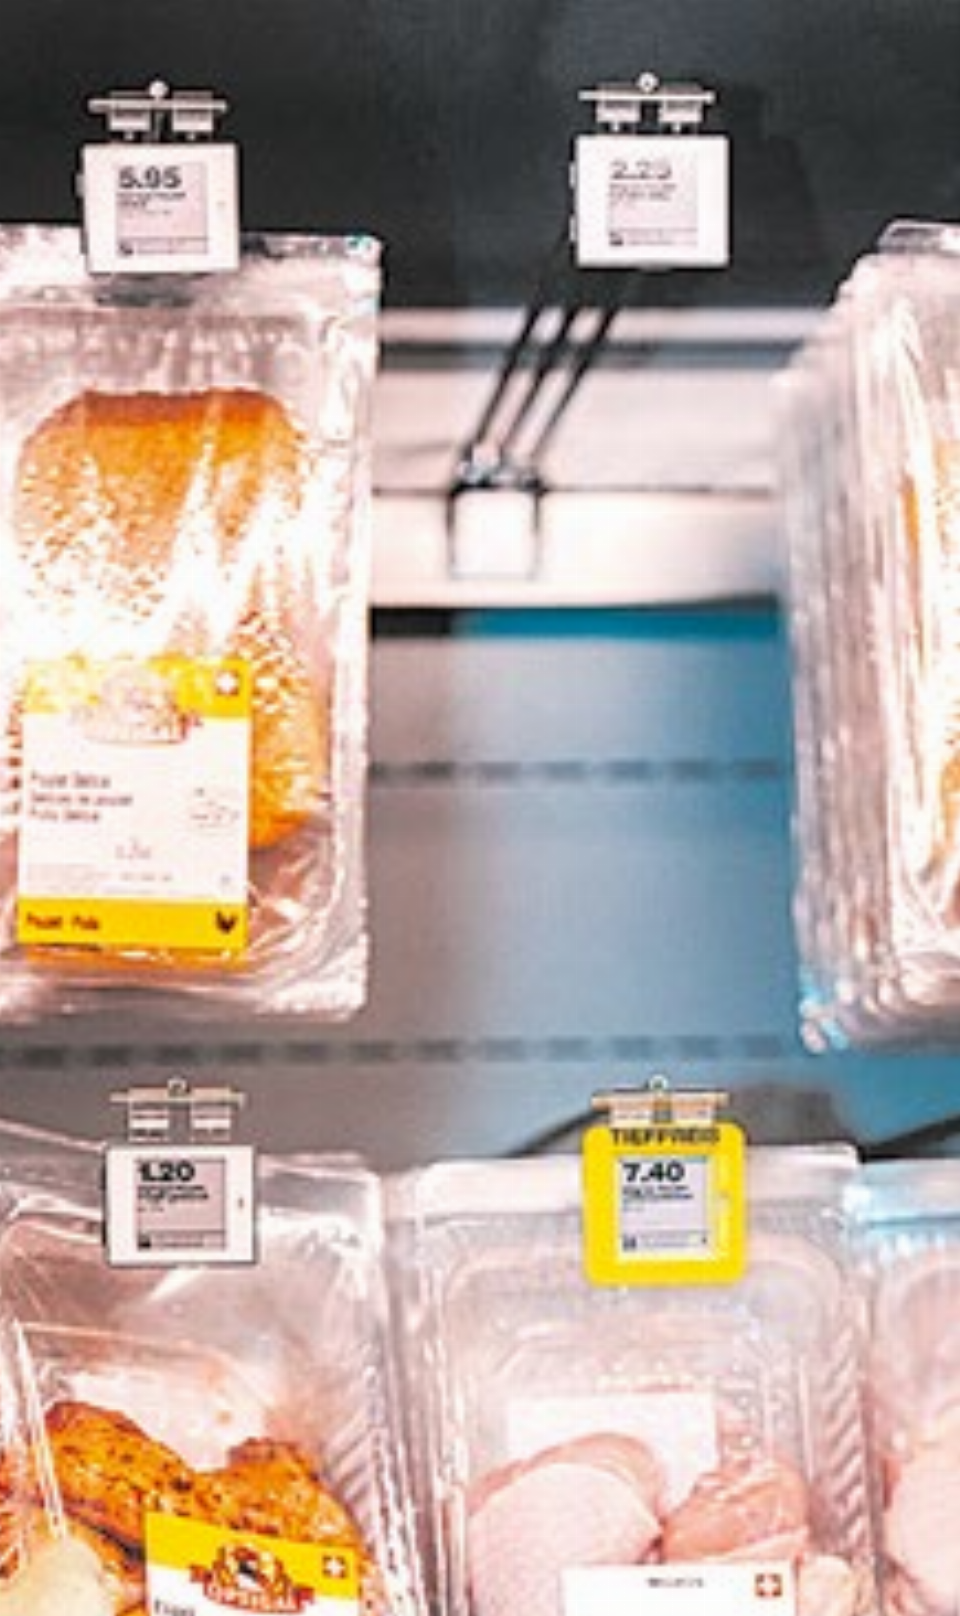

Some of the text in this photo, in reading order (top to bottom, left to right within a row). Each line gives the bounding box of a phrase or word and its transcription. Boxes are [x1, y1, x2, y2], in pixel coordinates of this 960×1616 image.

[610, 1128, 721, 1145] TIEFPREIS
[138, 1160, 196, 1182] 1.20
[622, 1161, 685, 1183] 7.40
